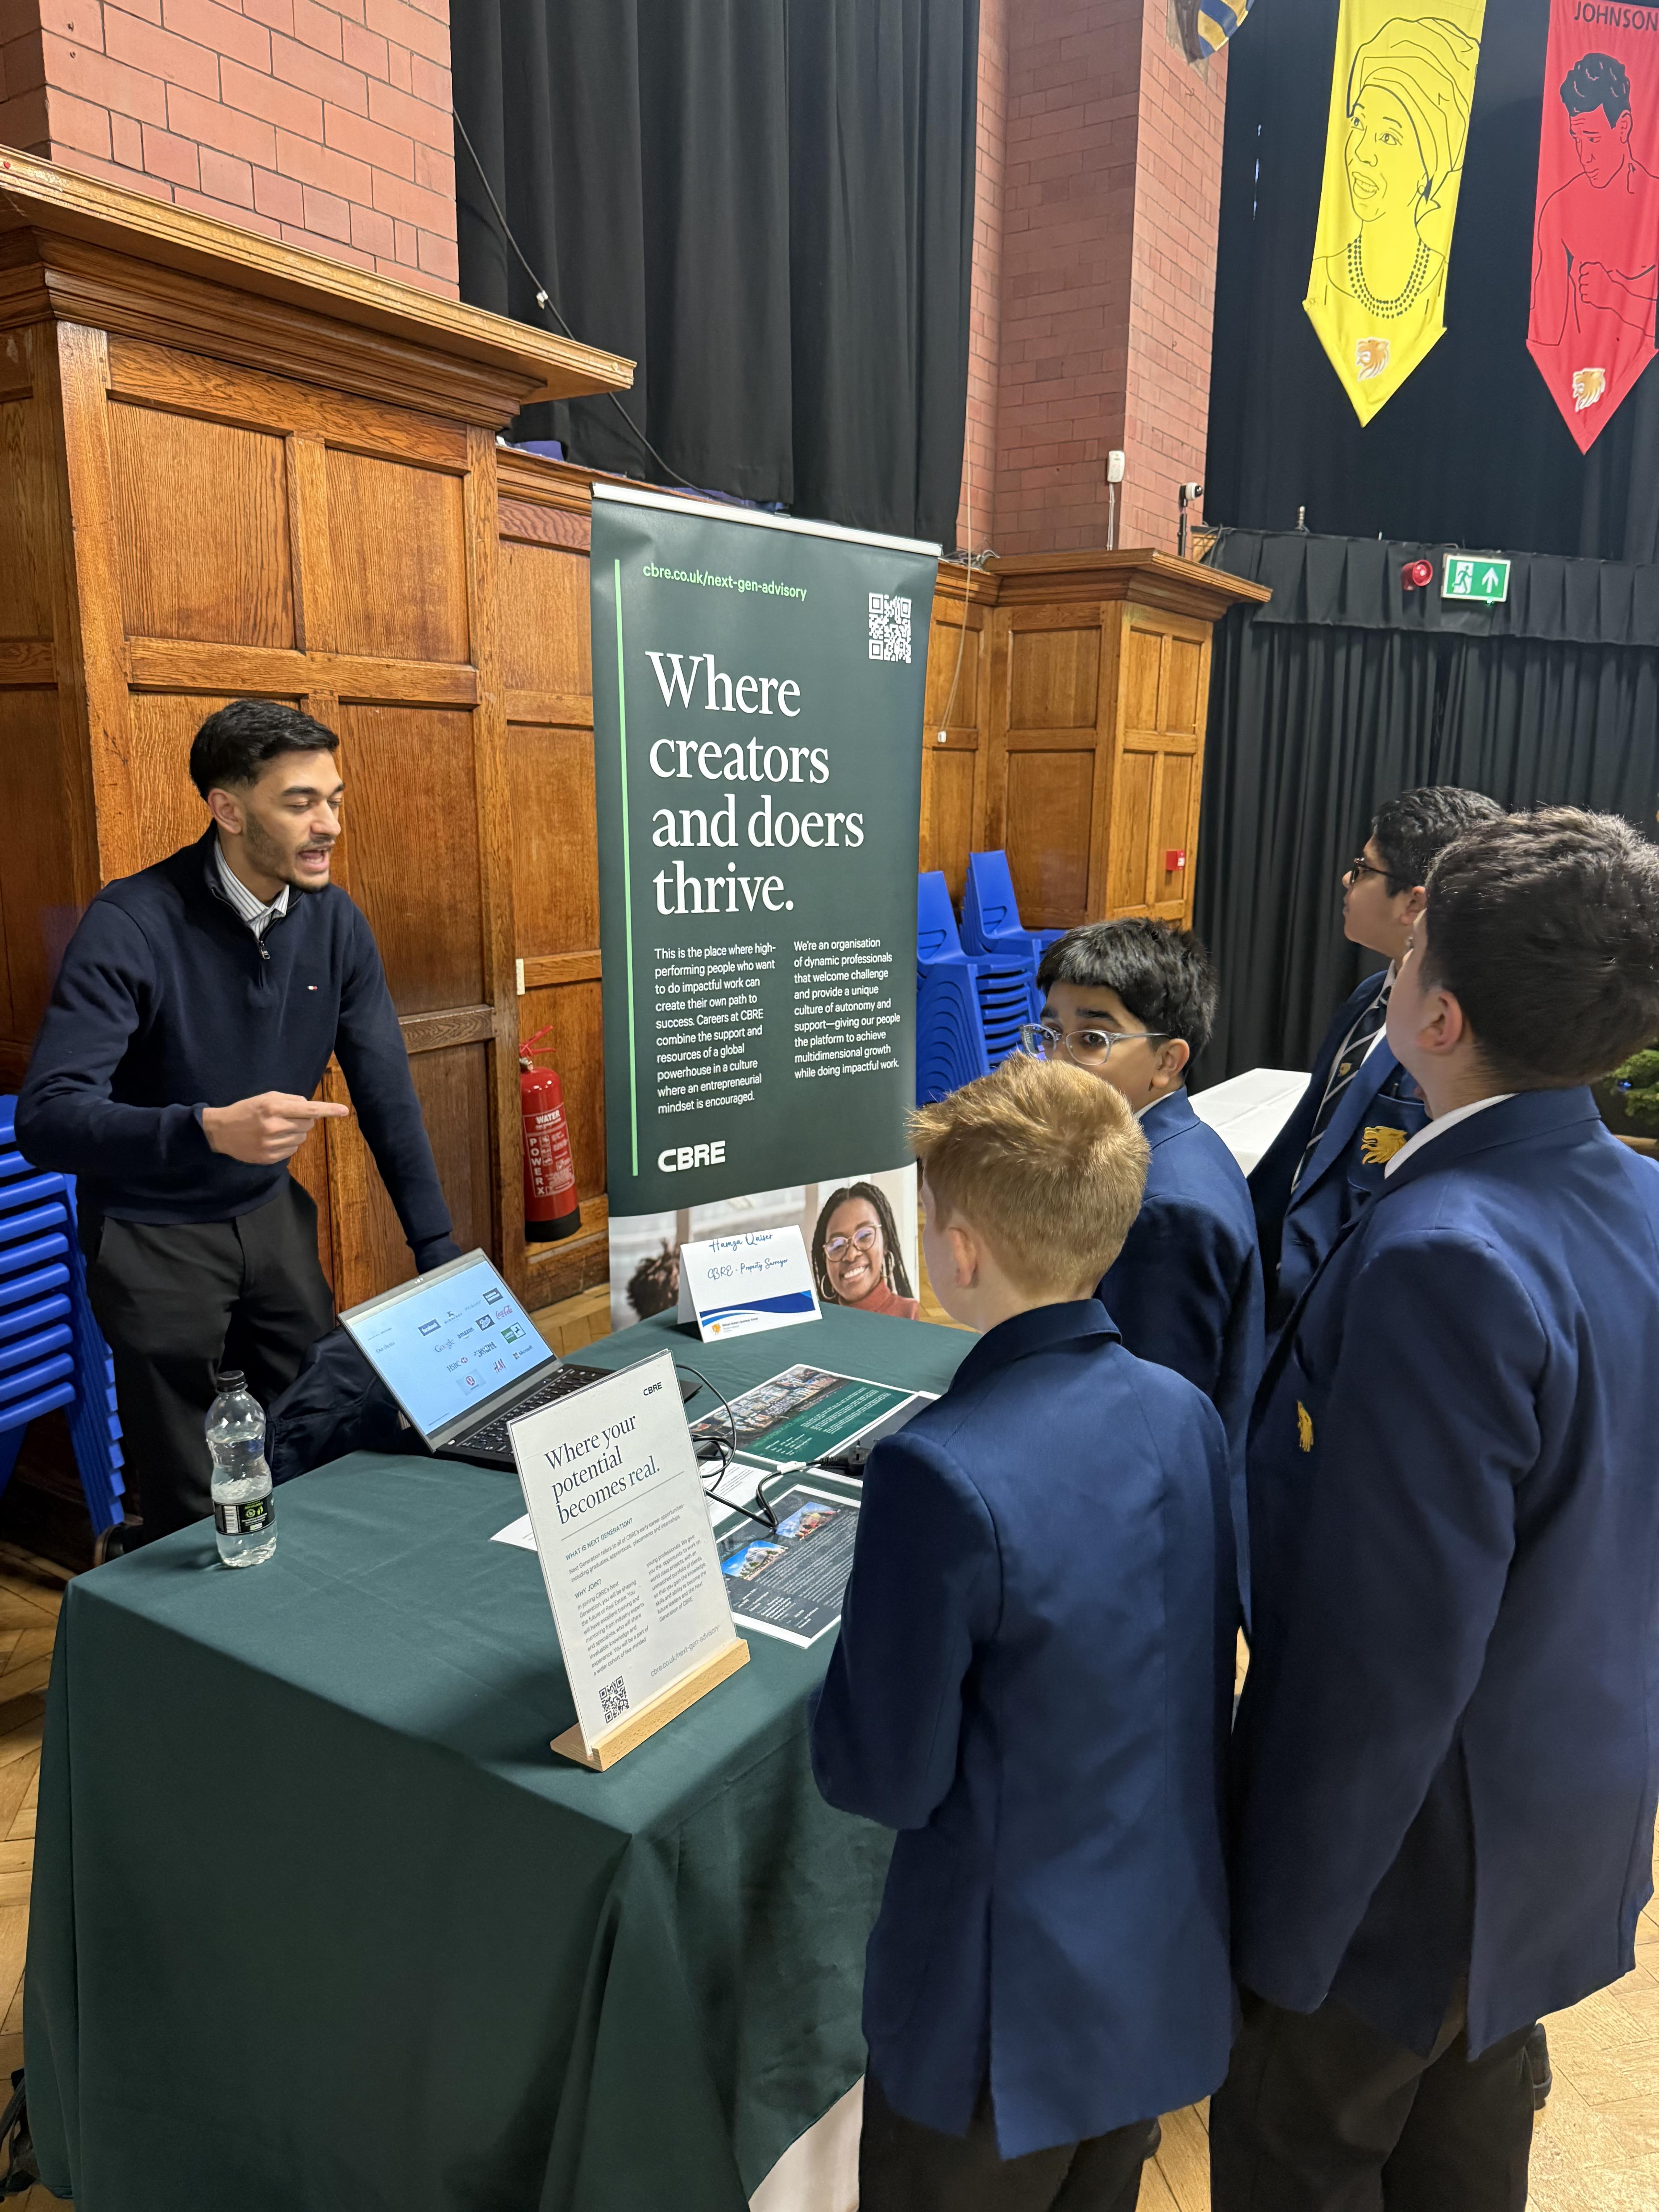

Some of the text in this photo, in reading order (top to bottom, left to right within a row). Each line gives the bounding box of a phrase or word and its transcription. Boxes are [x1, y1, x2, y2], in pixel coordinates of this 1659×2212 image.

[1574, 1, 1658, 31] JOHNSON
[643, 561, 807, 601] cbre.co.uk/next-gen-advisory
[645, 651, 801, 717] Where
[649, 736, 829, 784] creators
[652, 793, 864, 847] and doers
[653, 860, 794, 915] thrive.
[654, 942, 776, 959] This is the place where high-
[793, 938, 881, 951] We're an organisation
[655, 960, 775, 979] performing people who want
[794, 952, 892, 969] of dynamic professionals
[655, 977, 760, 994] to do impactful work can
[794, 969, 888, 984] that welcome challenge
[655, 993, 757, 1012] create their own path to
[794, 985, 879, 1000] and provide a unique
[794, 998, 891, 1016] culture of autonomy and
[656, 1008, 764, 1029] success. Careers at CBRE
[861, 1017, 875, 1025] our
[876, 1013, 900, 1026] people
[656, 1024, 762, 1046] combine the support and
[794, 1030, 886, 1048] the platform to achieve
[657, 1042, 745, 1063] resources of a global
[795, 1044, 891, 1063] multidimensional growth
[657, 1060, 758, 1082] powerhouse in a culture
[795, 1058, 899, 1079] while doing impactful work.
[657, 1073, 762, 1097] where an entrepreneurial
[658, 1090, 755, 1114] mindset is encouraged.
[536, 1110, 560, 1124] WATER
[658, 1140, 726, 1172] CBRE
[643, 1382, 663, 1396] CBRE
[544, 1416, 635, 1470] Where your
[551, 1446, 623, 1504] potential
[556, 1455, 660, 1524] becomes real.
[565, 1547, 580, 1561] WHAT
[587, 1536, 599, 1548] NEXT
[601, 1518, 632, 1540] GENERATION?
[574, 1578, 601, 1599] WHY JOIN?
